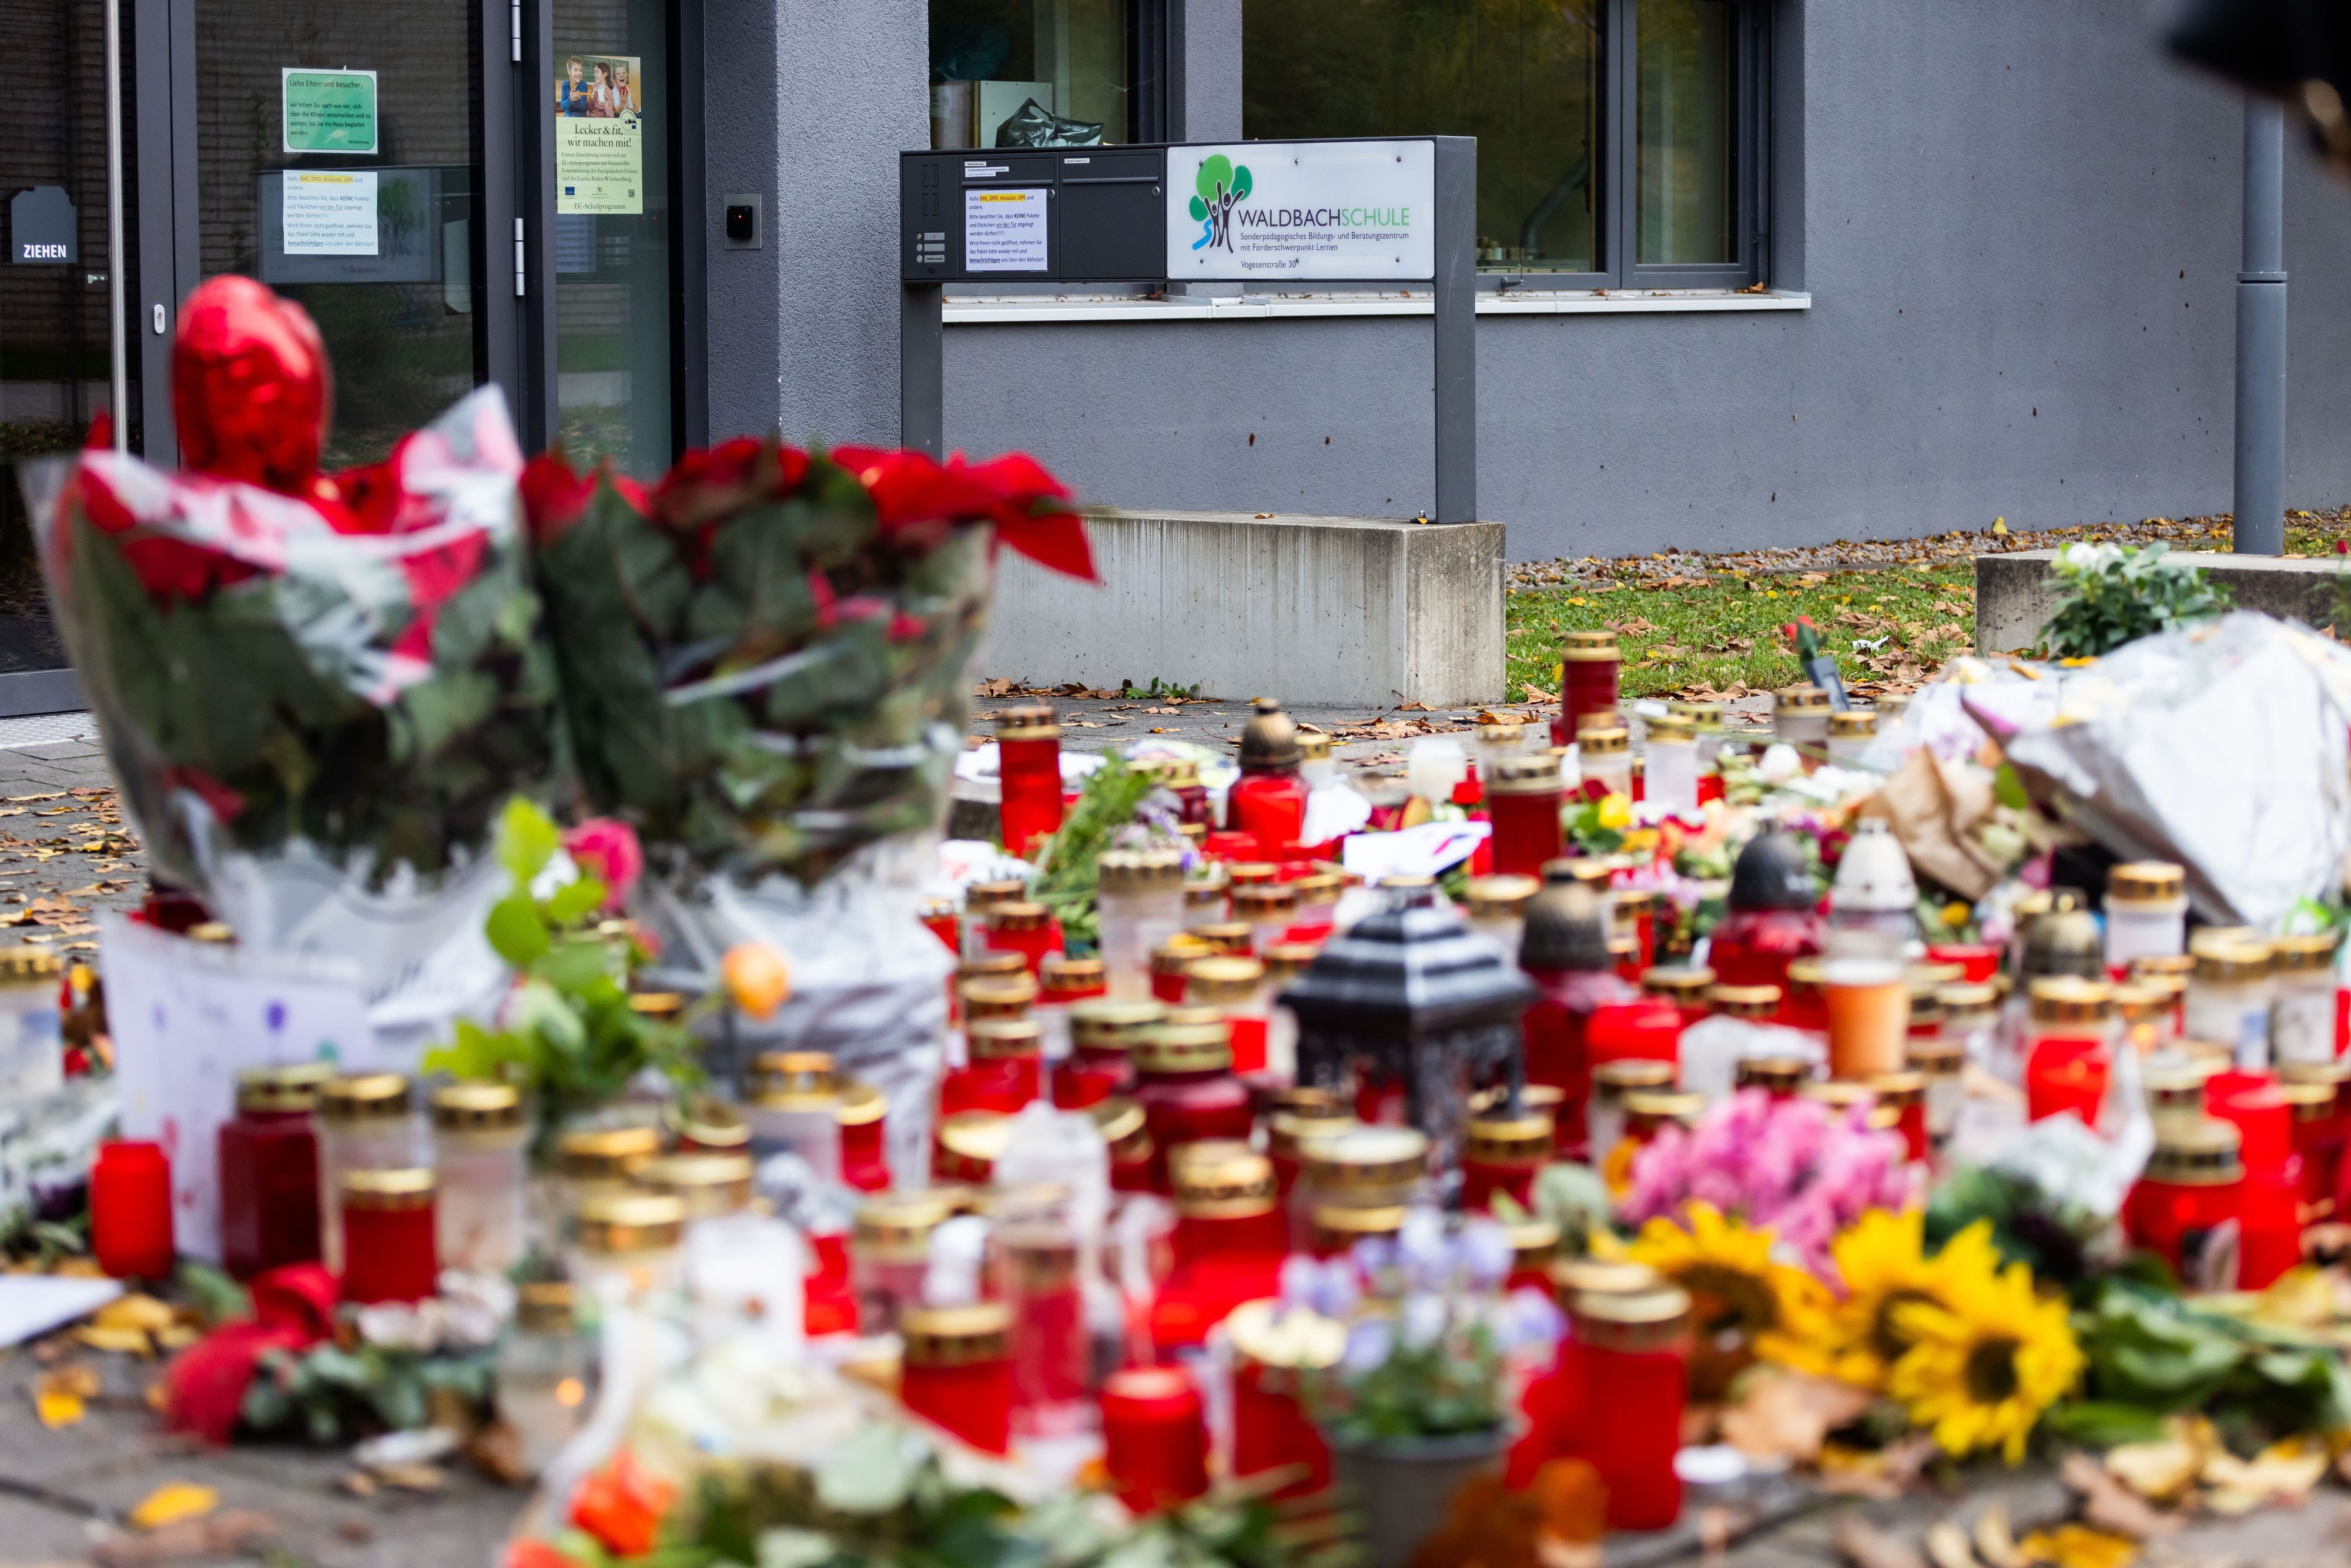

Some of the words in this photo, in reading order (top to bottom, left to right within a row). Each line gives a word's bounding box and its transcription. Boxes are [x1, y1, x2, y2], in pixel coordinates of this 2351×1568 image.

[575, 124, 602, 134] Lecker
[603, 126, 610, 134] &
[612, 125, 623, 136] fit,
[568, 137, 581, 146] wir
[583, 137, 613, 147] machen
[616, 138, 631, 147] mit!
[1238, 208, 1409, 227] WALDBACHSCHULE
[1240, 232, 1306, 242] Sonderpädagogisches
[1309, 232, 1335, 242] Bildungs-
[1352, 232, 1409, 241] Beratungszentrum
[24, 245, 66, 258] ZIEHEN
[1253, 243, 1314, 252] Förderschwerpunkt
[1241, 260, 1286, 270] Vogesenstraße
